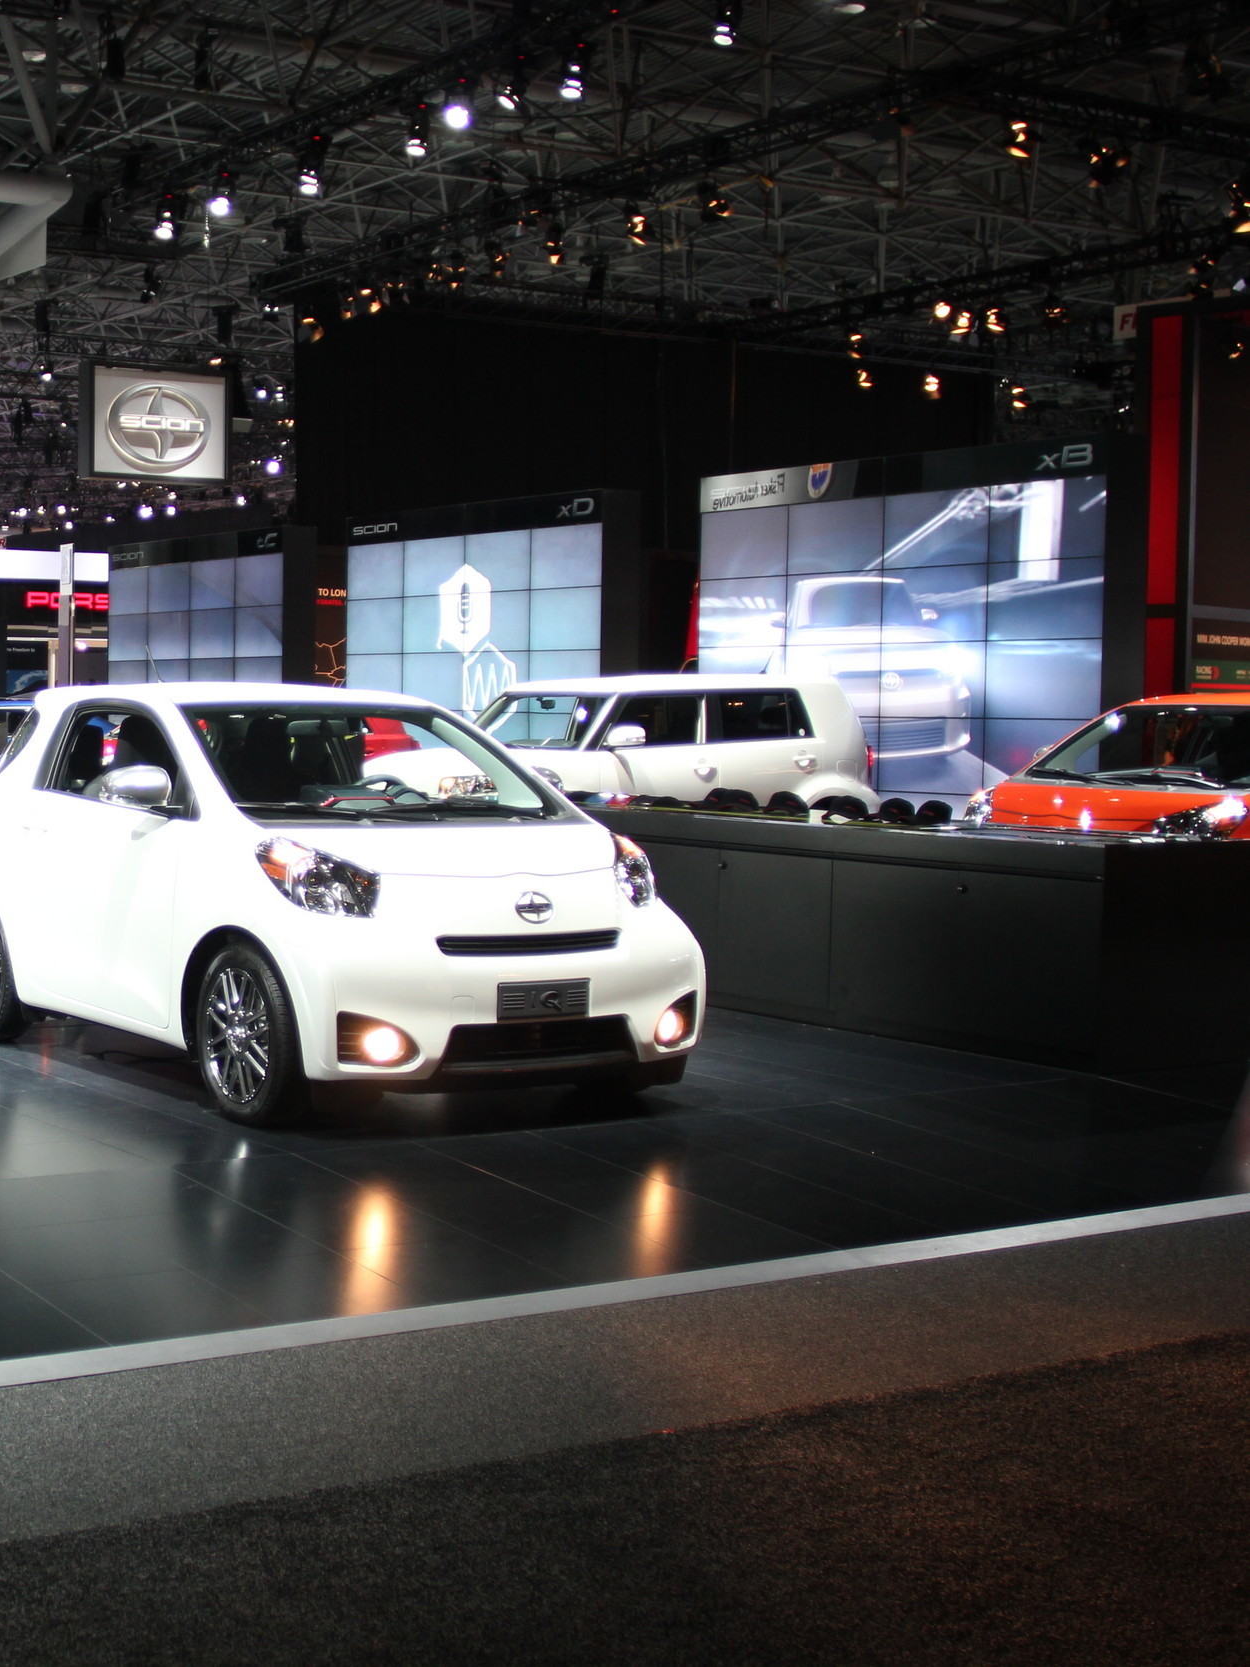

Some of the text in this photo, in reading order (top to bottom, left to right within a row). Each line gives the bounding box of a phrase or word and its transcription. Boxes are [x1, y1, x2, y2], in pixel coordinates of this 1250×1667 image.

[1034, 443, 1093, 471] xB
[556, 497, 594, 518] xD
[318, 588, 329, 597] TO
